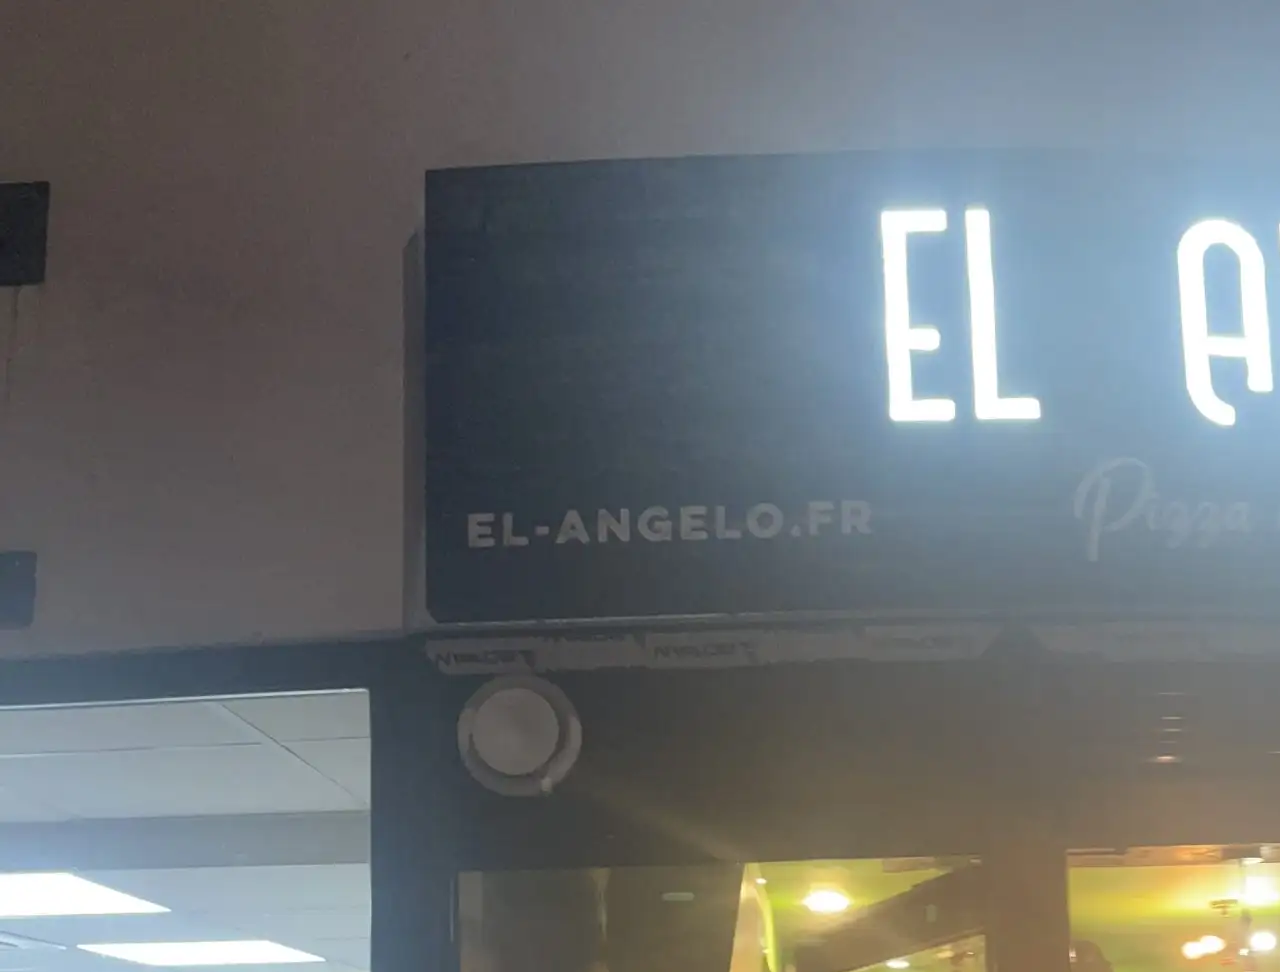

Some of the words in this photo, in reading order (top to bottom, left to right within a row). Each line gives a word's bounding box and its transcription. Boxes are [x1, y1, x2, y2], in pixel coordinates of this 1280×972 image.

[879, 205, 1043, 424] EL
[466, 499, 875, 550] EL-ANGELO.FR
[1073, 456, 1253, 562] Pizza
